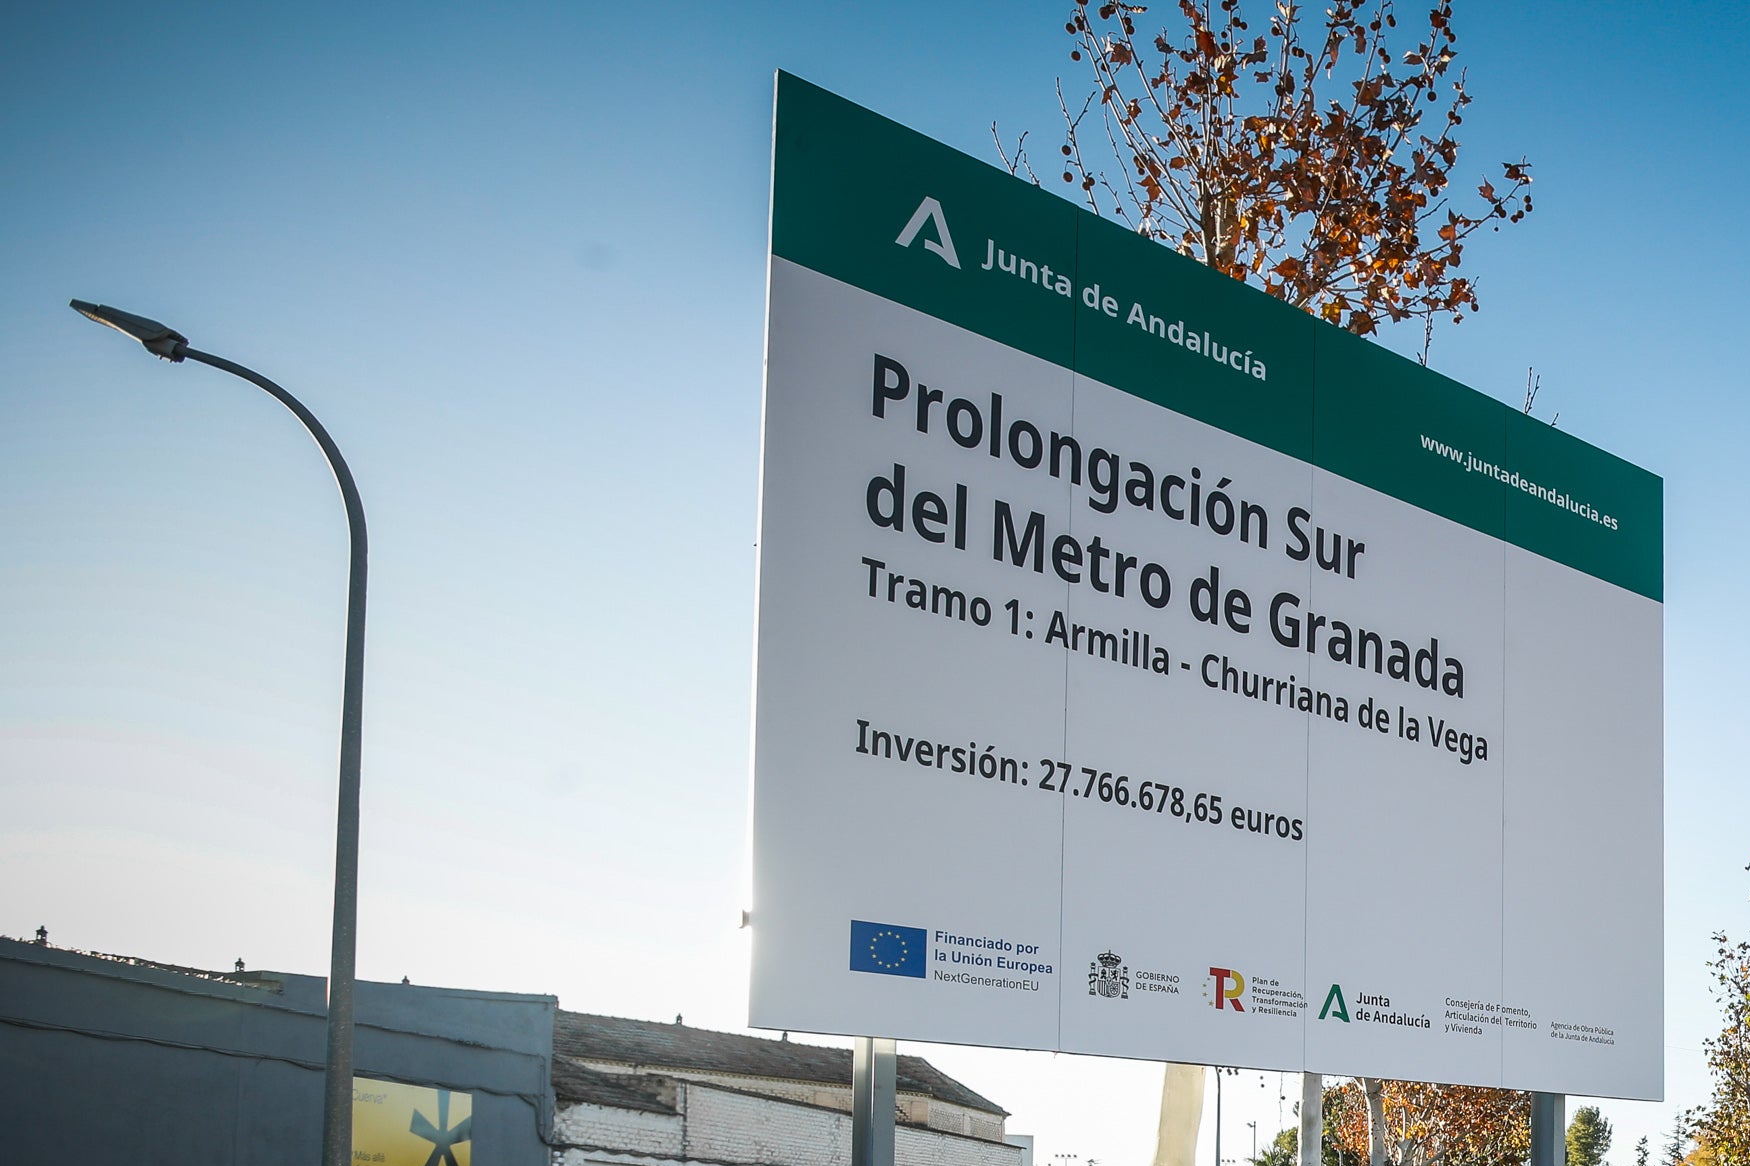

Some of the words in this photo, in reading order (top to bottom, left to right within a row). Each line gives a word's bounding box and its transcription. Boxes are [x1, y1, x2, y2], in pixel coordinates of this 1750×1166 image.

[981, 238, 1073, 298] Junta
[1082, 285, 1119, 318] de
[1127, 302, 1267, 381] Andalucía
[871, 353, 1269, 550] Prolongación
[1285, 506, 1366, 580] Sur
[1420, 434, 1618, 531] www.juntadeandalucia.es
[865, 463, 968, 551] del
[993, 499, 1172, 610] Metro
[1189, 565, 1252, 634] de
[1269, 591, 1465, 700] Granada
[861, 556, 992, 627] Tramo
[1004, 598, 1035, 639] 1:
[1045, 609, 1171, 676] Armilla
[1200, 652, 1350, 723] Churriana
[1357, 695, 1390, 735] de
[1398, 706, 1420, 743] la
[1427, 715, 1489, 766] Vega
[855, 719, 1029, 787] Inversión:
[1038, 757, 1224, 826] 27.766.678,65
[1230, 806, 1304, 841] euros
[935, 930, 1012, 951] Financiado
[1016, 943, 1039, 955] por
[934, 949, 946, 961] la
[951, 951, 992, 967] Unión
[997, 956, 1053, 974] Europea
[934, 970, 1039, 991] NextGenerationEU
[1135, 971, 1180, 984] GOBIERNO
[1252, 976, 1267, 986] Plan
[1270, 979, 1279, 987] de
[1135, 982, 1147, 990] DE
[1149, 982, 1179, 994] ESPAÑA
[1252, 986, 1304, 1000] Recuperación,
[1252, 996, 1308, 1009] Transformación
[1356, 992, 1390, 1008] Junta
[1445, 997, 1484, 1011] Consejería
[1485, 1002, 1495, 1011] de
[1258, 1006, 1297, 1017] Resiliencia
[1355, 1008, 1371, 1022] de
[1373, 1011, 1431, 1029] Andalucía
[1445, 1010, 1489, 1024] Articulación
[1490, 1015, 1502, 1025] del
[1504, 1017, 1537, 1029] Territorio
[1445, 1024, 1450, 1033] y
[1451, 1023, 1482, 1034] Vivienda
